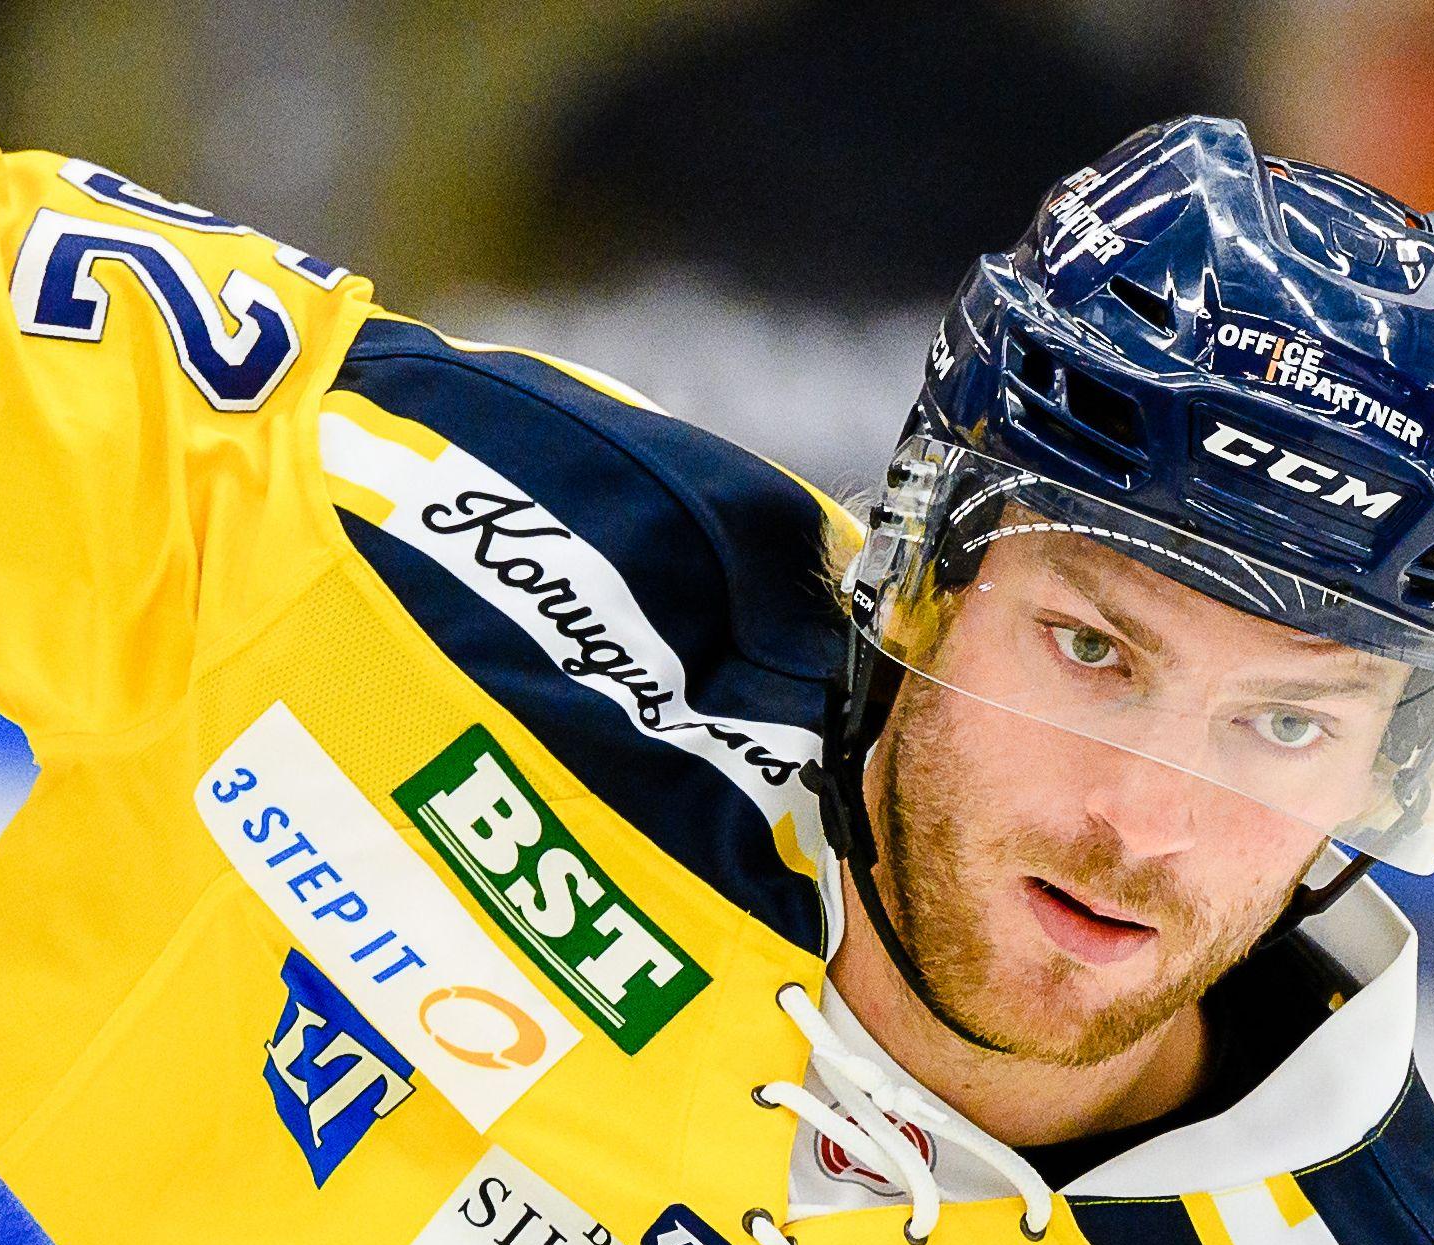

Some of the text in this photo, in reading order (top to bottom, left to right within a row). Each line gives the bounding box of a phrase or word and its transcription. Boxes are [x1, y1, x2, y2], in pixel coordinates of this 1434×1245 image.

[1217, 323, 1325, 371] OFFICE
[1201, 420, 1404, 520] CCM
[853, 588, 875, 612] CCM
[211, 767, 427, 985] 3 STEP IT
[437, 751, 685, 1006] BST
